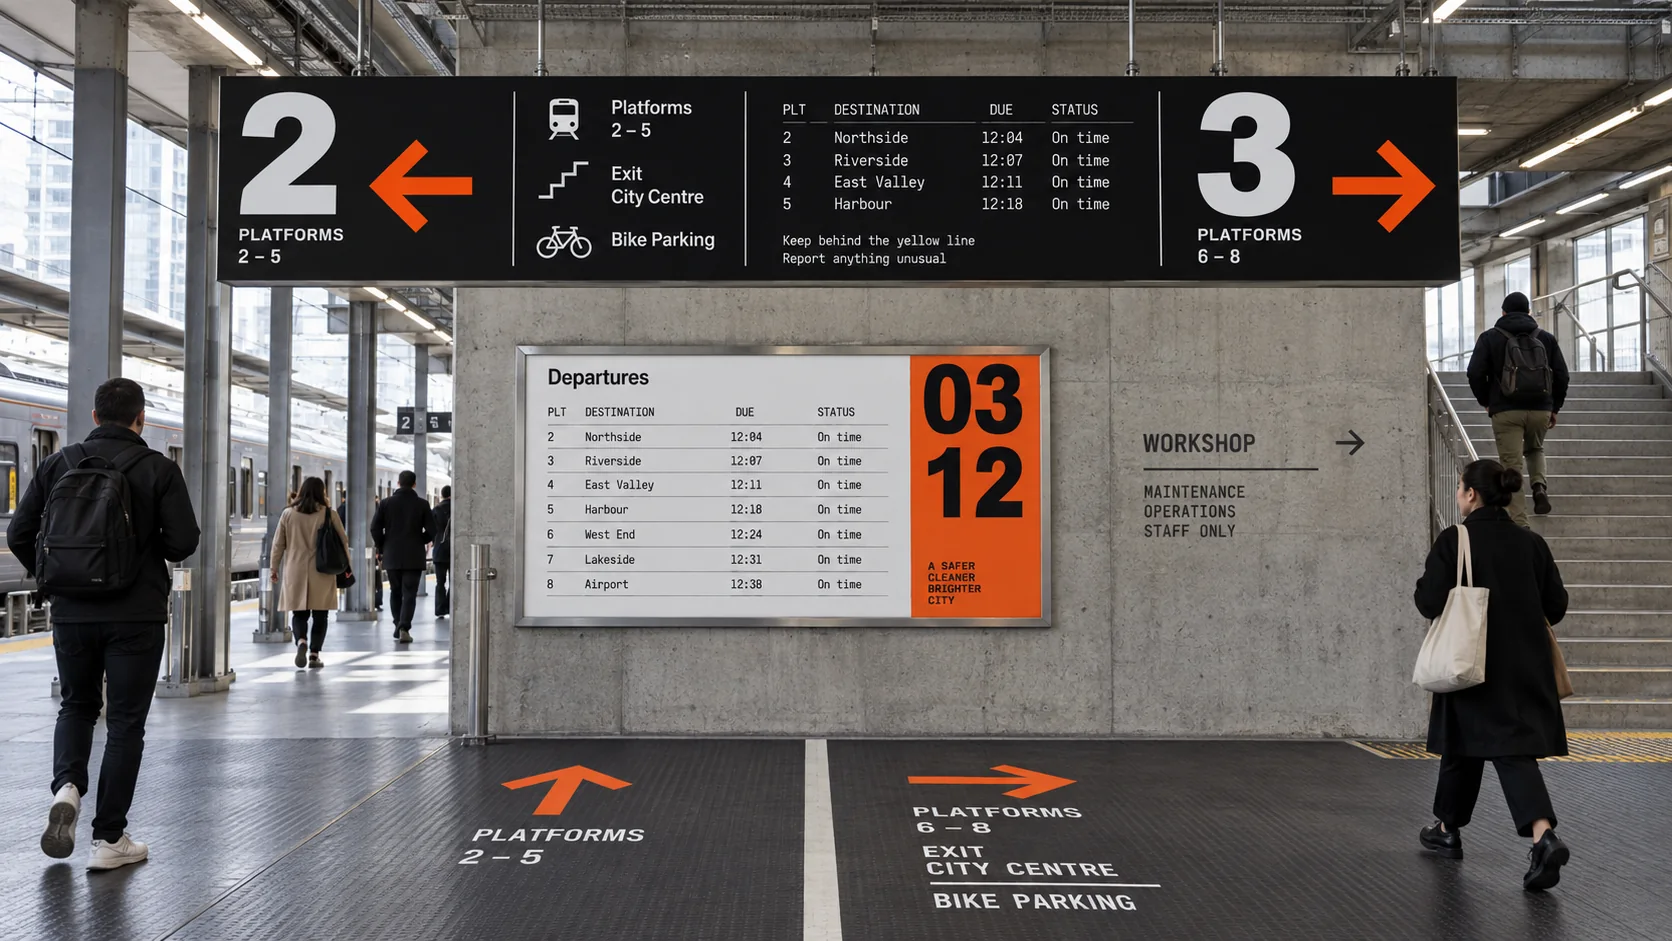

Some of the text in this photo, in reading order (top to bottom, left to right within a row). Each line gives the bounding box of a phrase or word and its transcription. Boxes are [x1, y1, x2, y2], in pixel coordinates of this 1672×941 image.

[611, 99, 693, 115] Platforms
[783, 103, 1099, 116] PLT DESTINATION DUE STATUS
[611, 123, 621, 138] 2
[641, 123, 651, 138] 5
[783, 131, 1110, 144] 2 Northside 12:04 On time
[240, 92, 336, 214] 2
[1198, 92, 1296, 217] 3
[783, 154, 1110, 167] 3 Riverside 12:07 On time
[611, 166, 643, 181] Exit
[783, 175, 1110, 192] 4 East Valley 12:11 On time
[611, 189, 704, 208] City Centre
[783, 197, 1110, 211] 5 Harbour 12:18 On time
[239, 228, 344, 242] PLATFORMS
[611, 232, 715, 251] Bike Parking
[783, 234, 976, 249] Keep behind the yellow line
[1198, 228, 1302, 242] PLATFORMS
[239, 249, 248, 263] 2
[271, 249, 281, 263] 5
[783, 253, 947, 267] Report anything unusual
[1198, 249, 1209, 263] 6
[1230, 249, 1241, 263] 8
[548, 368, 650, 389] Departures
[924, 363, 1023, 435] 03
[548, 407, 856, 417] PLT DESTINATION DUE STATUS
[401, 416, 410, 429] 2
[547, 432, 862, 442] 2 Northside 12:04 On time
[1143, 432, 1256, 453] WORKSHOP
[547, 456, 862, 466] 3 Riverside 12:07 On time
[547, 480, 862, 493] 4 East Valley 12:11 On time
[928, 446, 1023, 518] 12
[1144, 485, 1246, 499] MAINTENANCE
[547, 504, 862, 514] 5 Harbour 12:18 On time
[1144, 504, 1236, 518] OPERATIONS
[547, 529, 862, 539] 6 West End 12:24 On time
[1144, 524, 1236, 537] STAFF ONLY
[547, 554, 862, 564] 7 Lakeside 12:31 On time
[928, 562, 976, 571] A SAFER
[928, 573, 976, 583] CLEANER
[547, 579, 862, 592] 8 Airport 12:38 On time
[928, 584, 982, 594] BRIGHTER
[928, 595, 955, 605] CITY
[912, 806, 1083, 818] PLATFORMS
[472, 828, 645, 842] PLATFORMS
[916, 822, 935, 834] 6
[971, 822, 992, 834] 8
[458, 849, 484, 865] 2
[519, 849, 545, 865] 5
[923, 845, 984, 858] EXIT
[926, 861, 1119, 877] CITY CENTRE
[933, 892, 1137, 911] BIKE PARKING
